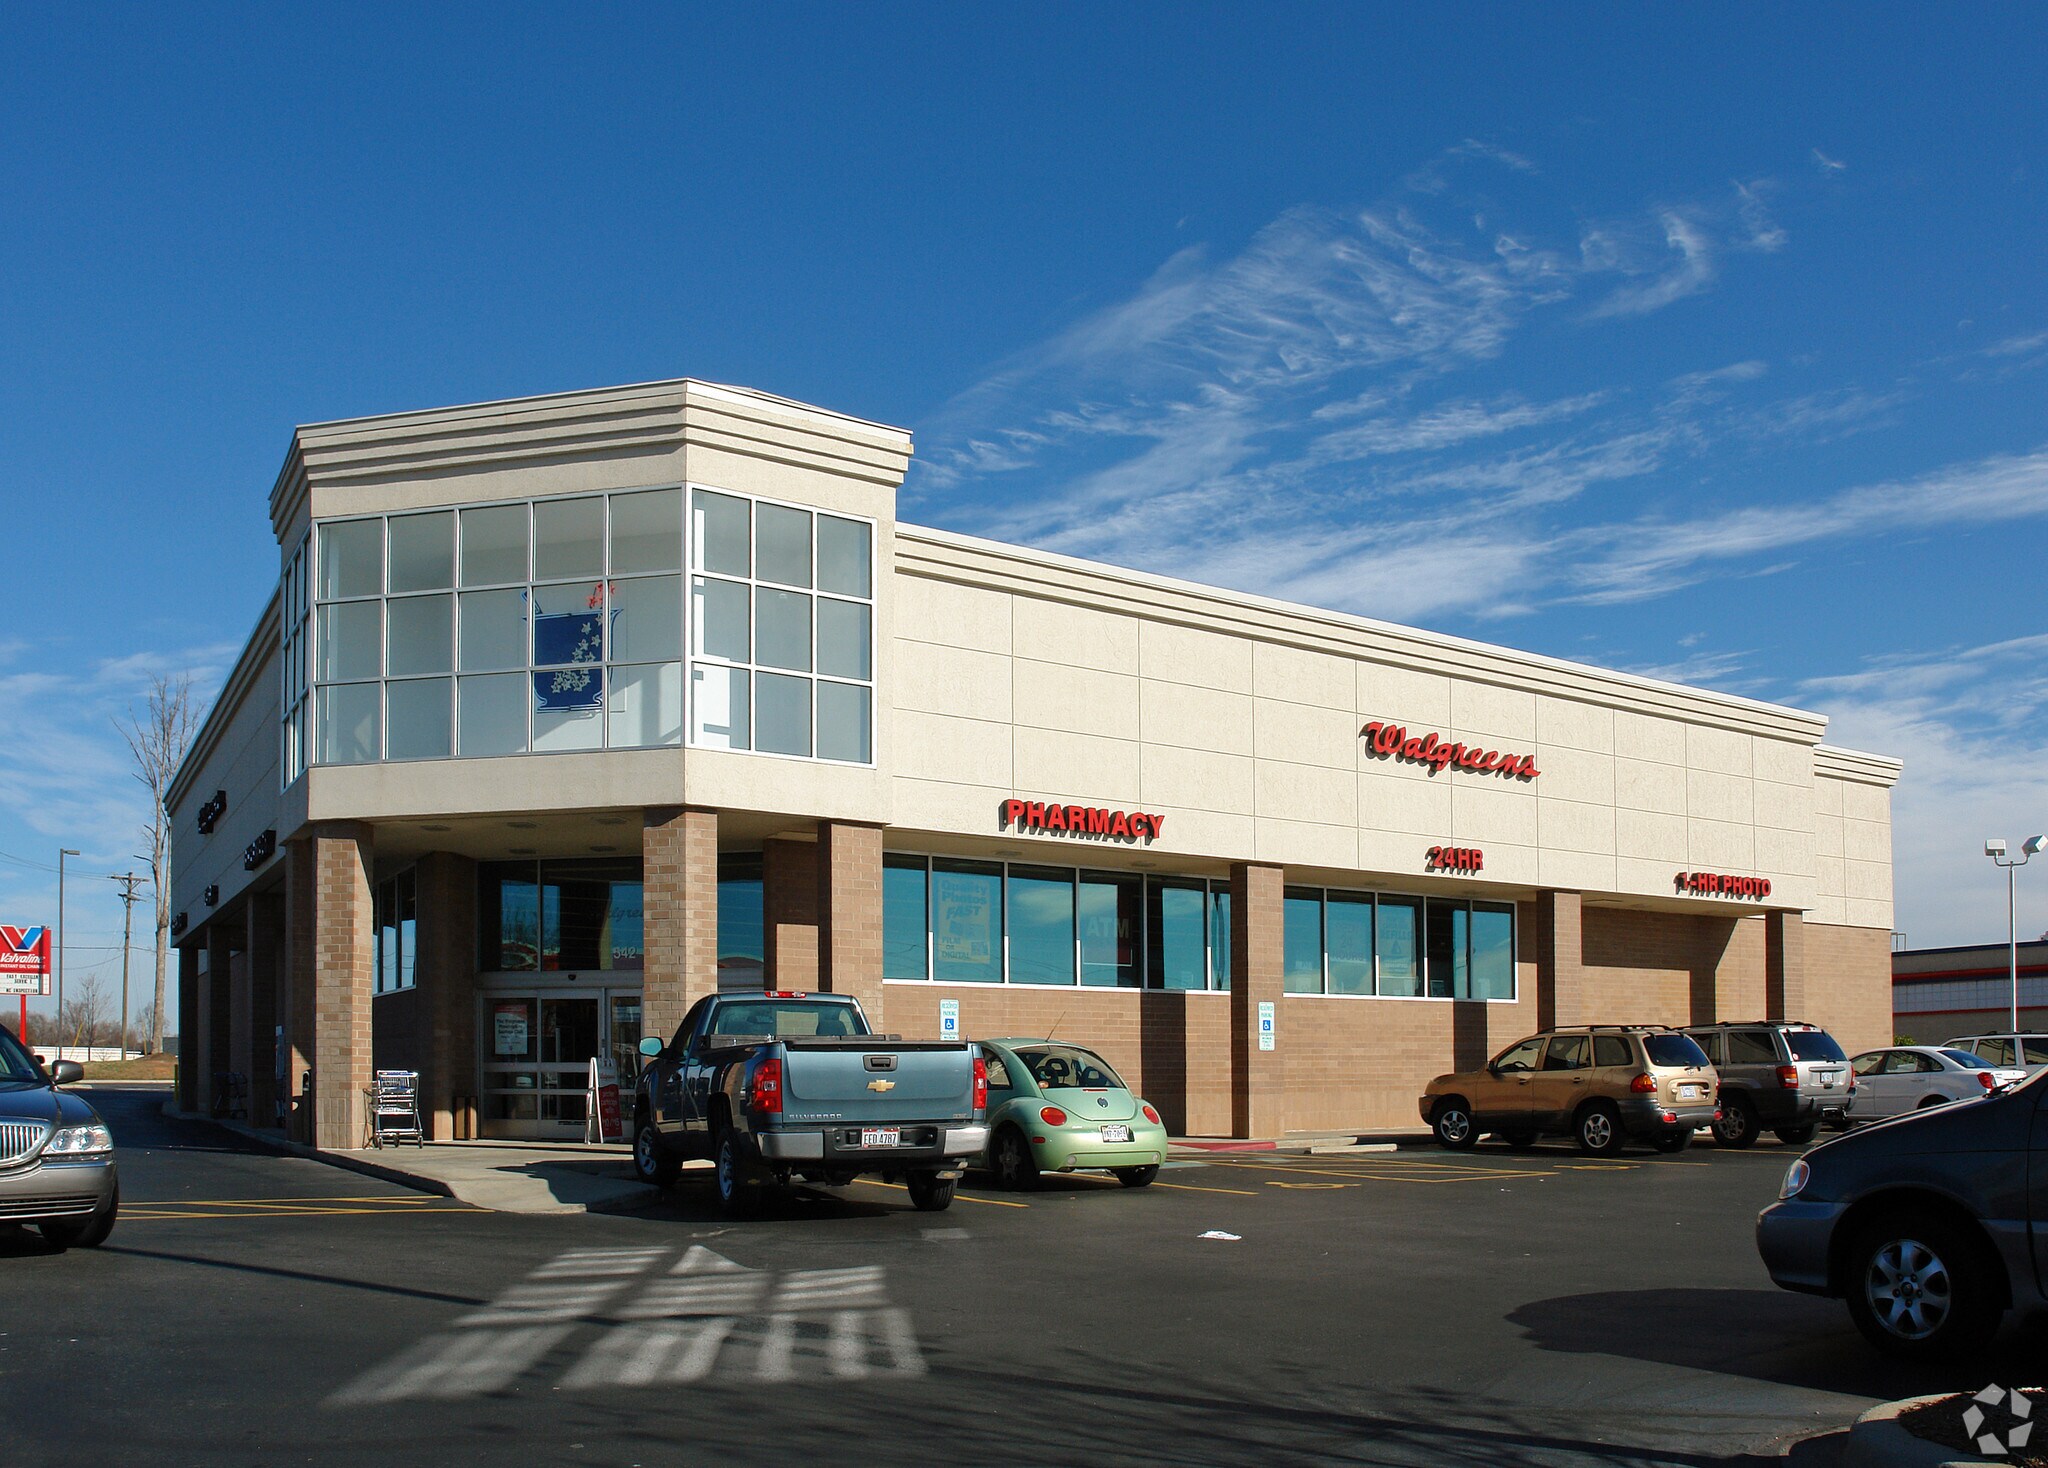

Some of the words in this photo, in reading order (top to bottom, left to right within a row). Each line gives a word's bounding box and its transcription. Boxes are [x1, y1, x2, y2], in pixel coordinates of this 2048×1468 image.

[1365, 721, 1541, 779] Walgreens
[1005, 799, 1165, 839] PHARMACY
[1429, 846, 1484, 872] 24HR
[1679, 871, 1719, 893] 1-HR
[1723, 874, 1771, 898] PHOTO
[945, 905, 981, 920] FAST
[1085, 916, 1129, 939] ATM
[0, 953, 43, 963] Valvoline
